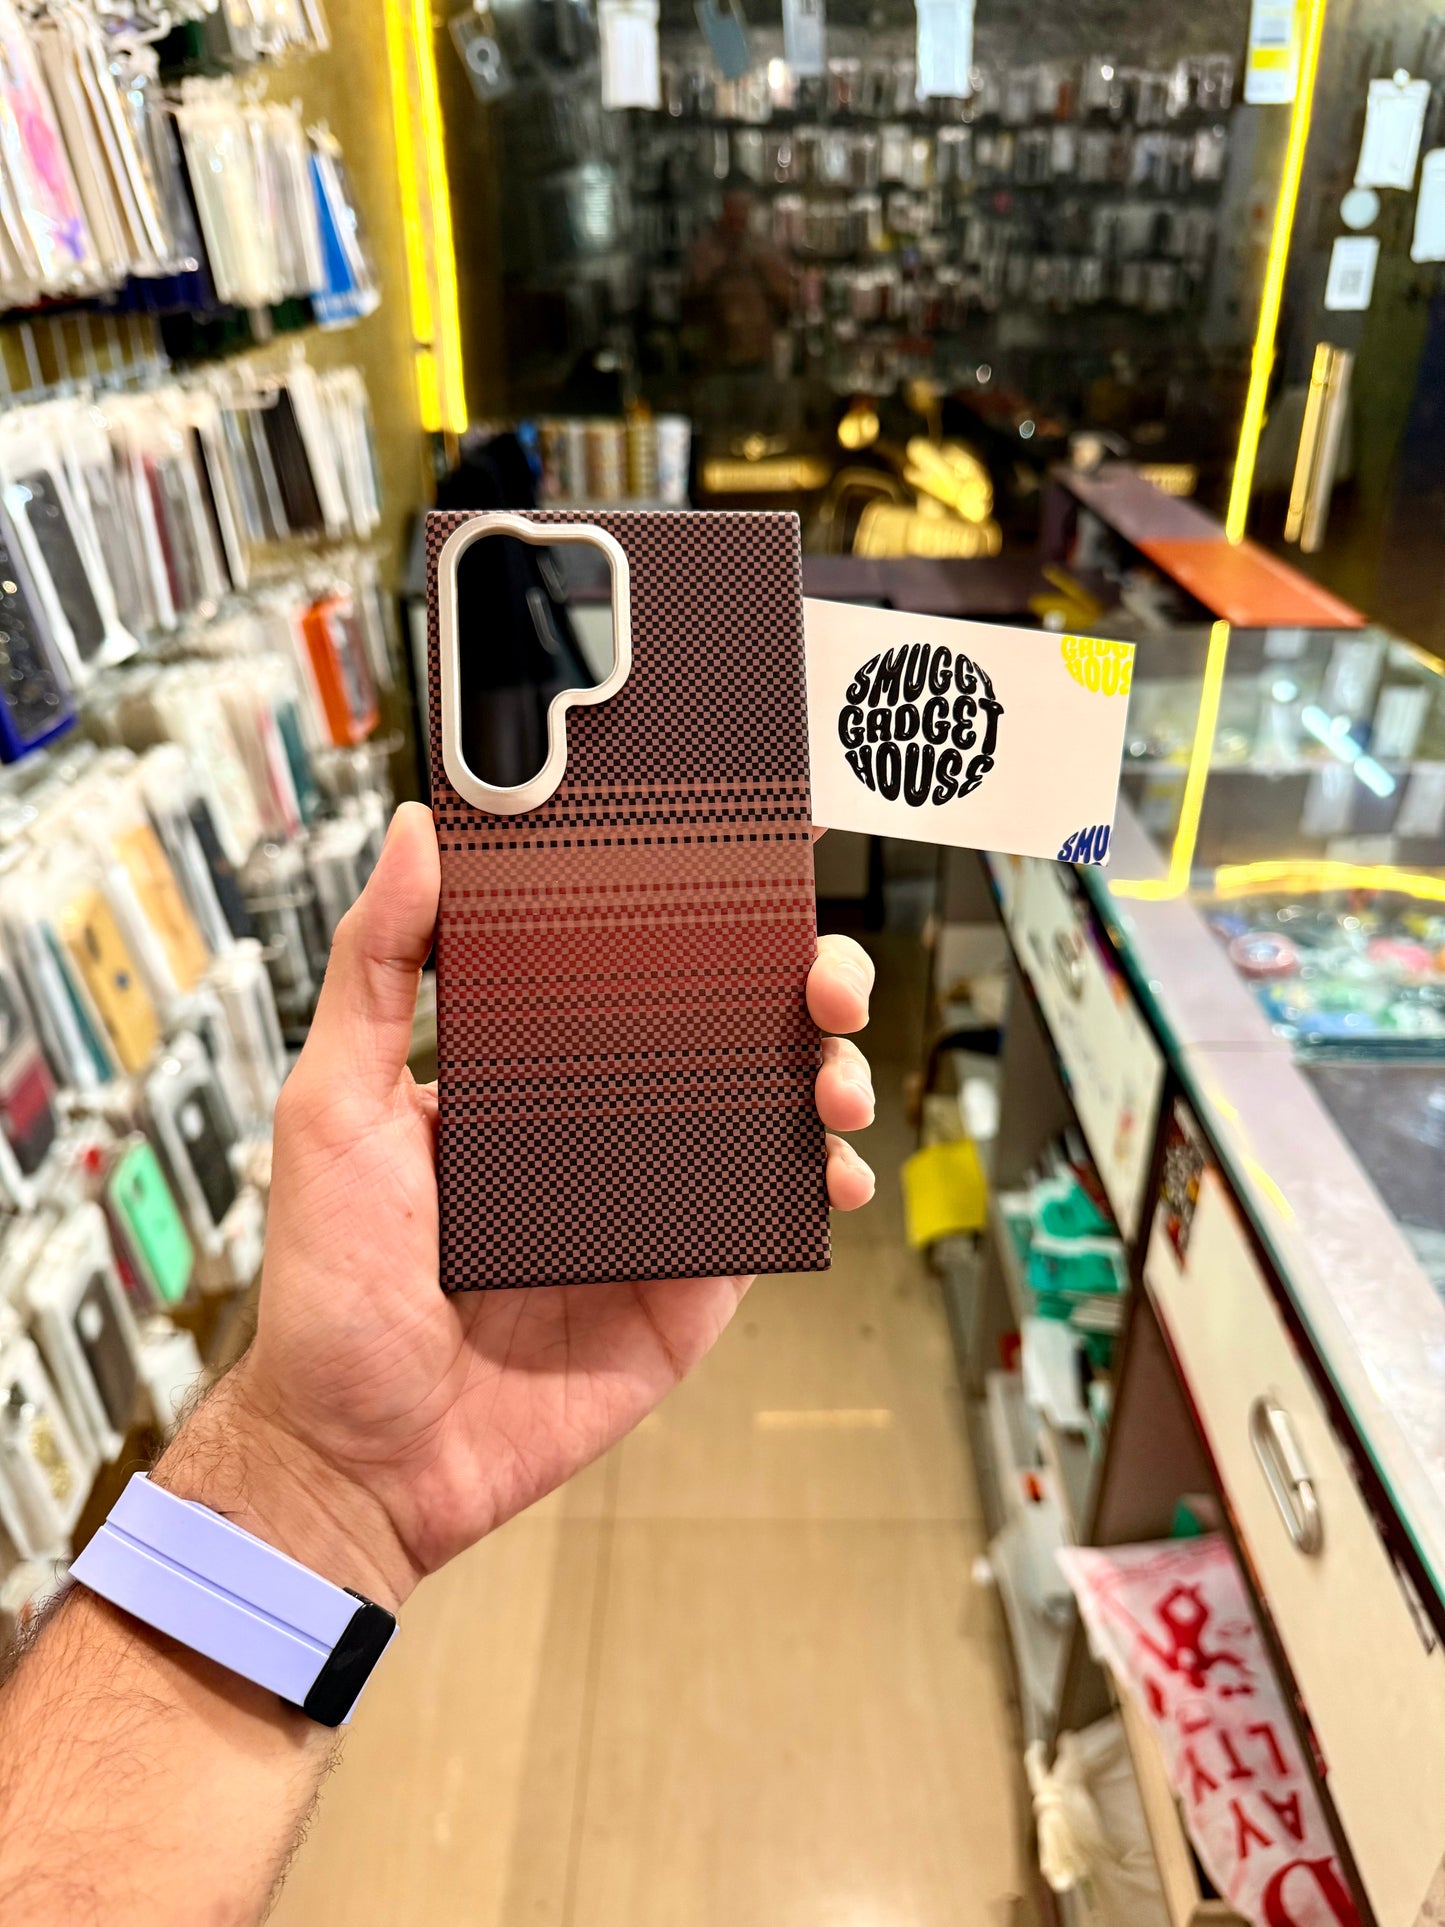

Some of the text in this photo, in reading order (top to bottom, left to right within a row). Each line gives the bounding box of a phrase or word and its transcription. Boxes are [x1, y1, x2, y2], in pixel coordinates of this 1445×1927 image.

[846, 643, 996, 708] SMUGGY
[1060, 634, 1134, 661] GADG
[838, 695, 1004, 755] GADGET
[845, 741, 995, 807] HOUSE
[1057, 825, 1110, 864] SMU
